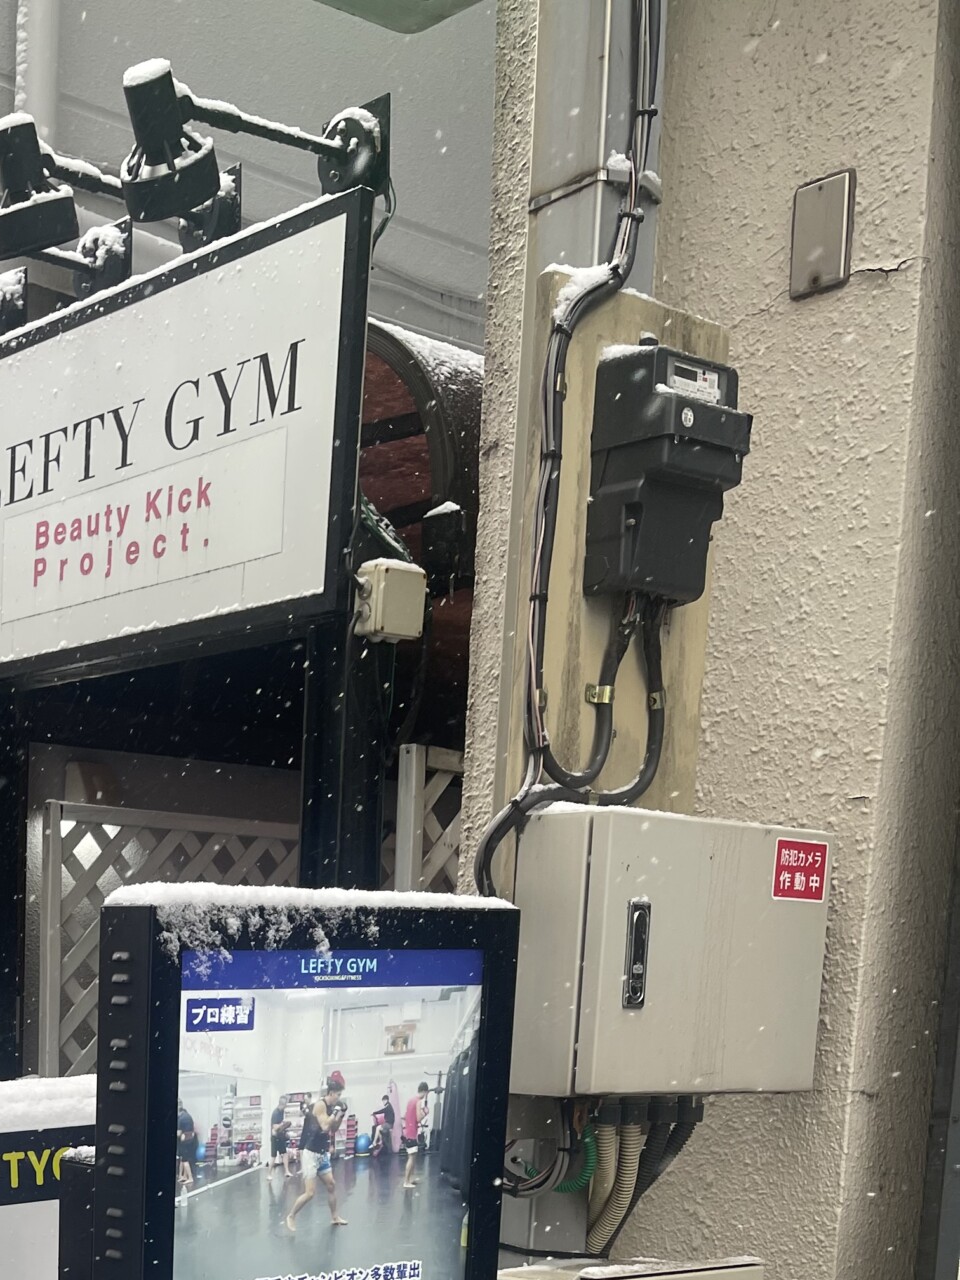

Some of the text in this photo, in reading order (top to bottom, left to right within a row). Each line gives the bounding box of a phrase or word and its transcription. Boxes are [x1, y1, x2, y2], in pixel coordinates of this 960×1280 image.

[164, 338, 306, 451] GYM
[35, 476, 212, 551] Beauty Kick
[780, 848, 822, 868] 防犯カメラ
[301, 958, 377, 974] LEFTY GYM
[191, 1004, 251, 1026] プロ練習
